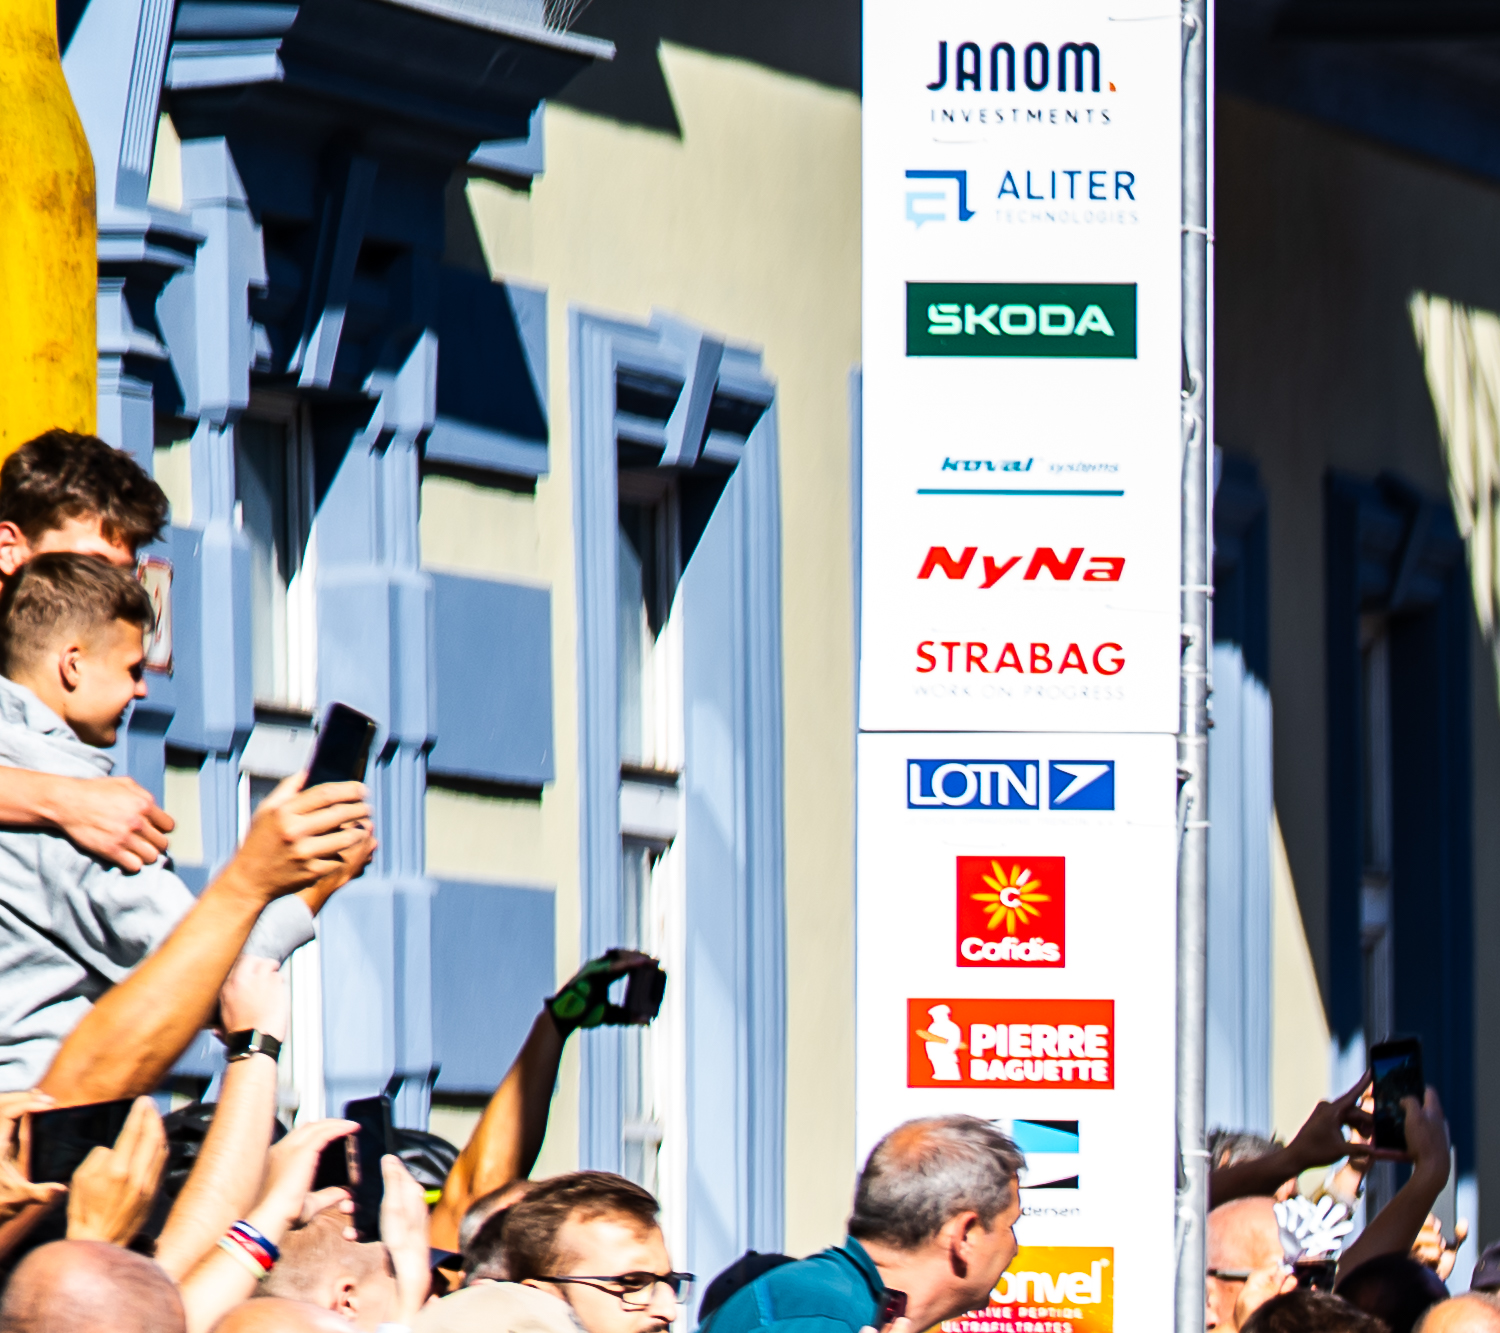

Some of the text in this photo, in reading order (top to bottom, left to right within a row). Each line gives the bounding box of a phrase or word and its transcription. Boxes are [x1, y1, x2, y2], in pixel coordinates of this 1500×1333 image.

[930, 108, 1111, 125] INVESTMENTS
[997, 170, 1136, 201] ALITER
[940, 457, 1035, 473] koval
[916, 546, 1126, 590] NyNa
[915, 641, 1126, 676] STRABAG
[909, 763, 1039, 806] LOTN
[960, 936, 1061, 963] Cofidis
[970, 1024, 1109, 1060] PIERRE
[970, 1059, 1109, 1082] BAGUETTE
[1020, 1205, 1081, 1217] dersen
[989, 1260, 1103, 1305] onvel
[941, 1321, 1073, 1333] ULTRAFILTRATES
[1018, 1307, 1084, 1320] PEPTIDE
